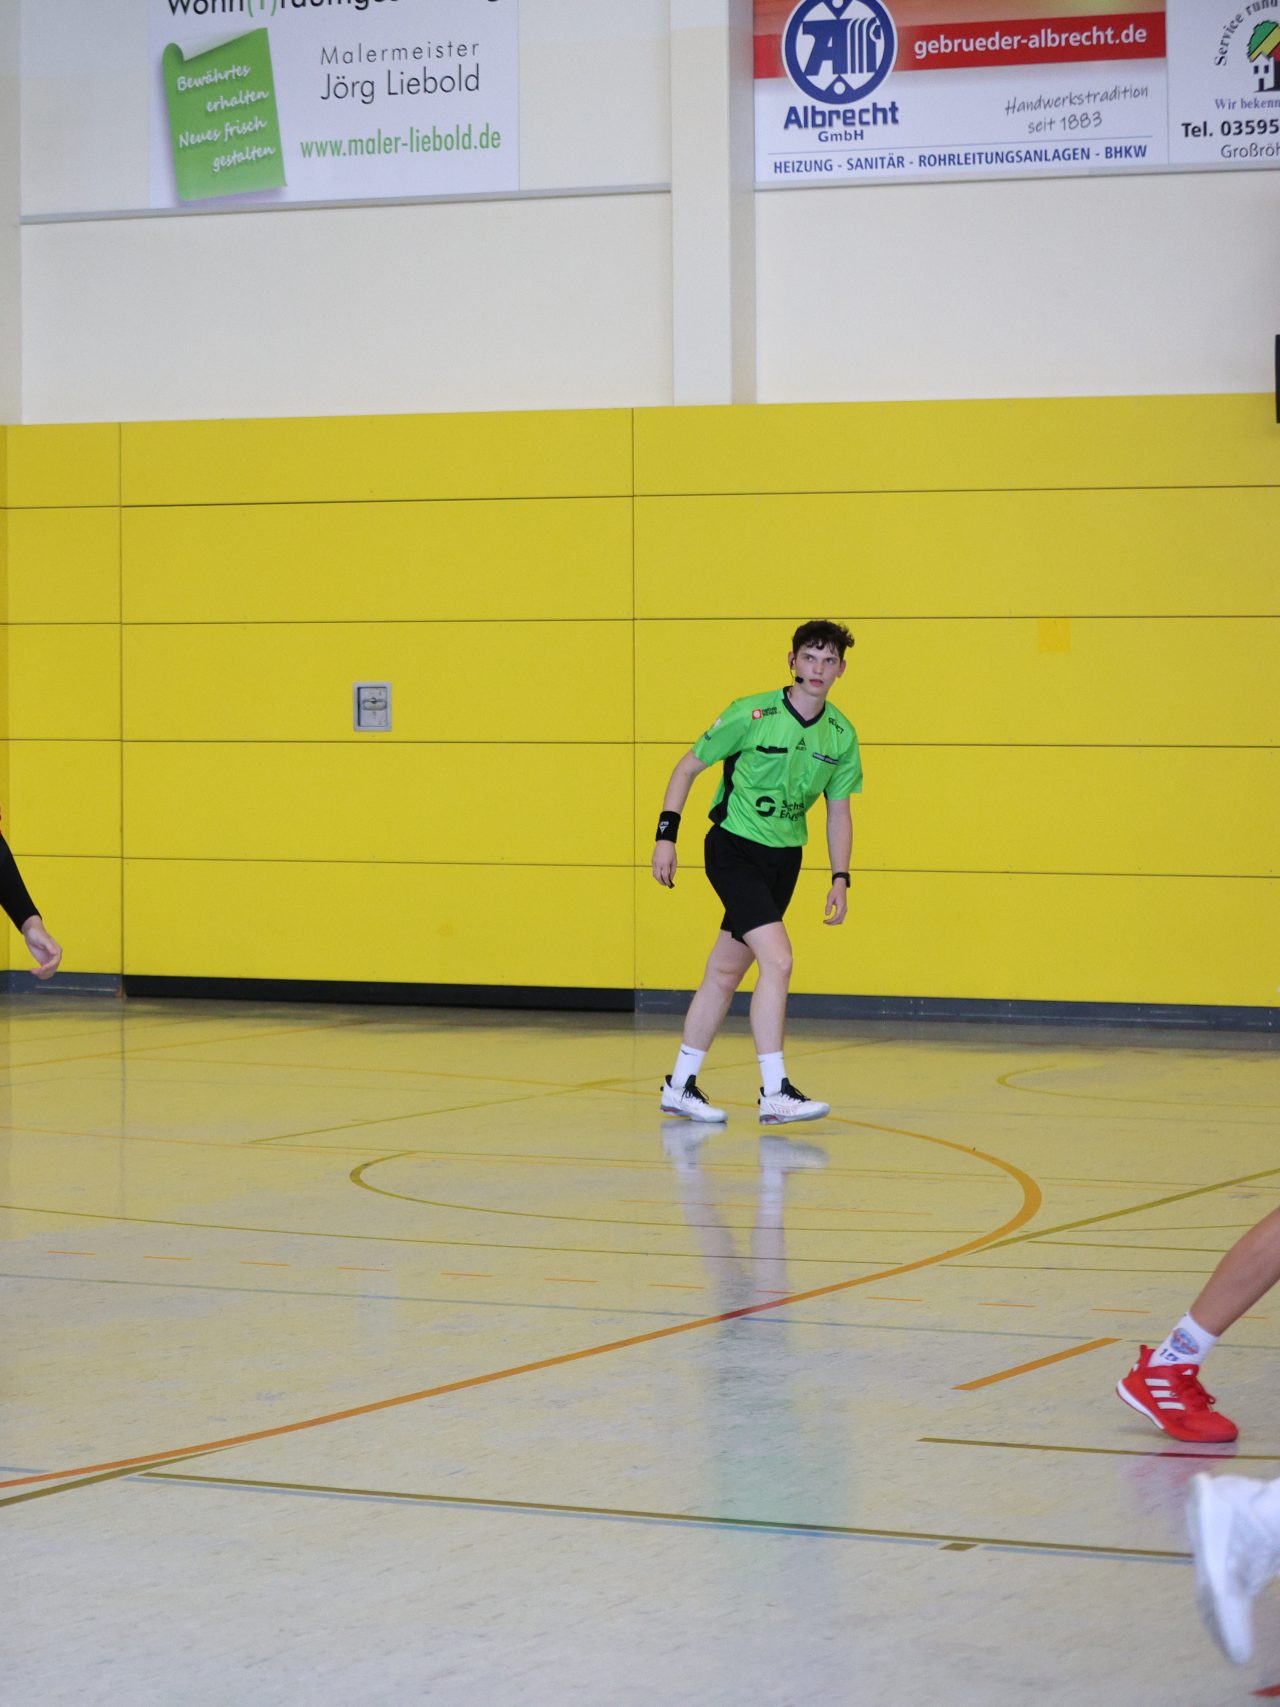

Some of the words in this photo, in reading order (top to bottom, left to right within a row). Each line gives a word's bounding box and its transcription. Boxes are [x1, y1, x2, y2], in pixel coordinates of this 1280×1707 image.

[320, 40, 480, 66] Malermeister
[914, 24, 1147, 60] gebrueder-albrecht.de
[1214, 14, 1244, 66] Service
[176, 63, 252, 93] Bewährtes
[320, 73, 376, 105] Jörg
[387, 63, 480, 97] Liebold
[206, 89, 269, 115] erhalten
[1005, 84, 1149, 116] Handwerkstradition
[1215, 98, 1237, 110] Wir
[783, 101, 899, 130] Albrecht
[1027, 117, 1056, 135] seit
[1060, 111, 1103, 132] 1883
[1181, 120, 1214, 138] Tel.
[1220, 119, 1280, 137] 03595
[178, 126, 221, 149] Neues
[222, 115, 268, 141] frisch
[300, 122, 502, 159] www.maler-liebold.de
[818, 130, 864, 143] GmbH
[212, 144, 277, 173] gestalten
[774, 159, 833, 175] HEIZUNG
[846, 153, 905, 171] SANITÄR
[919, 147, 1091, 168] ROHRLEITUNGSANLAGEN
[1105, 145, 1148, 160] BHKW
